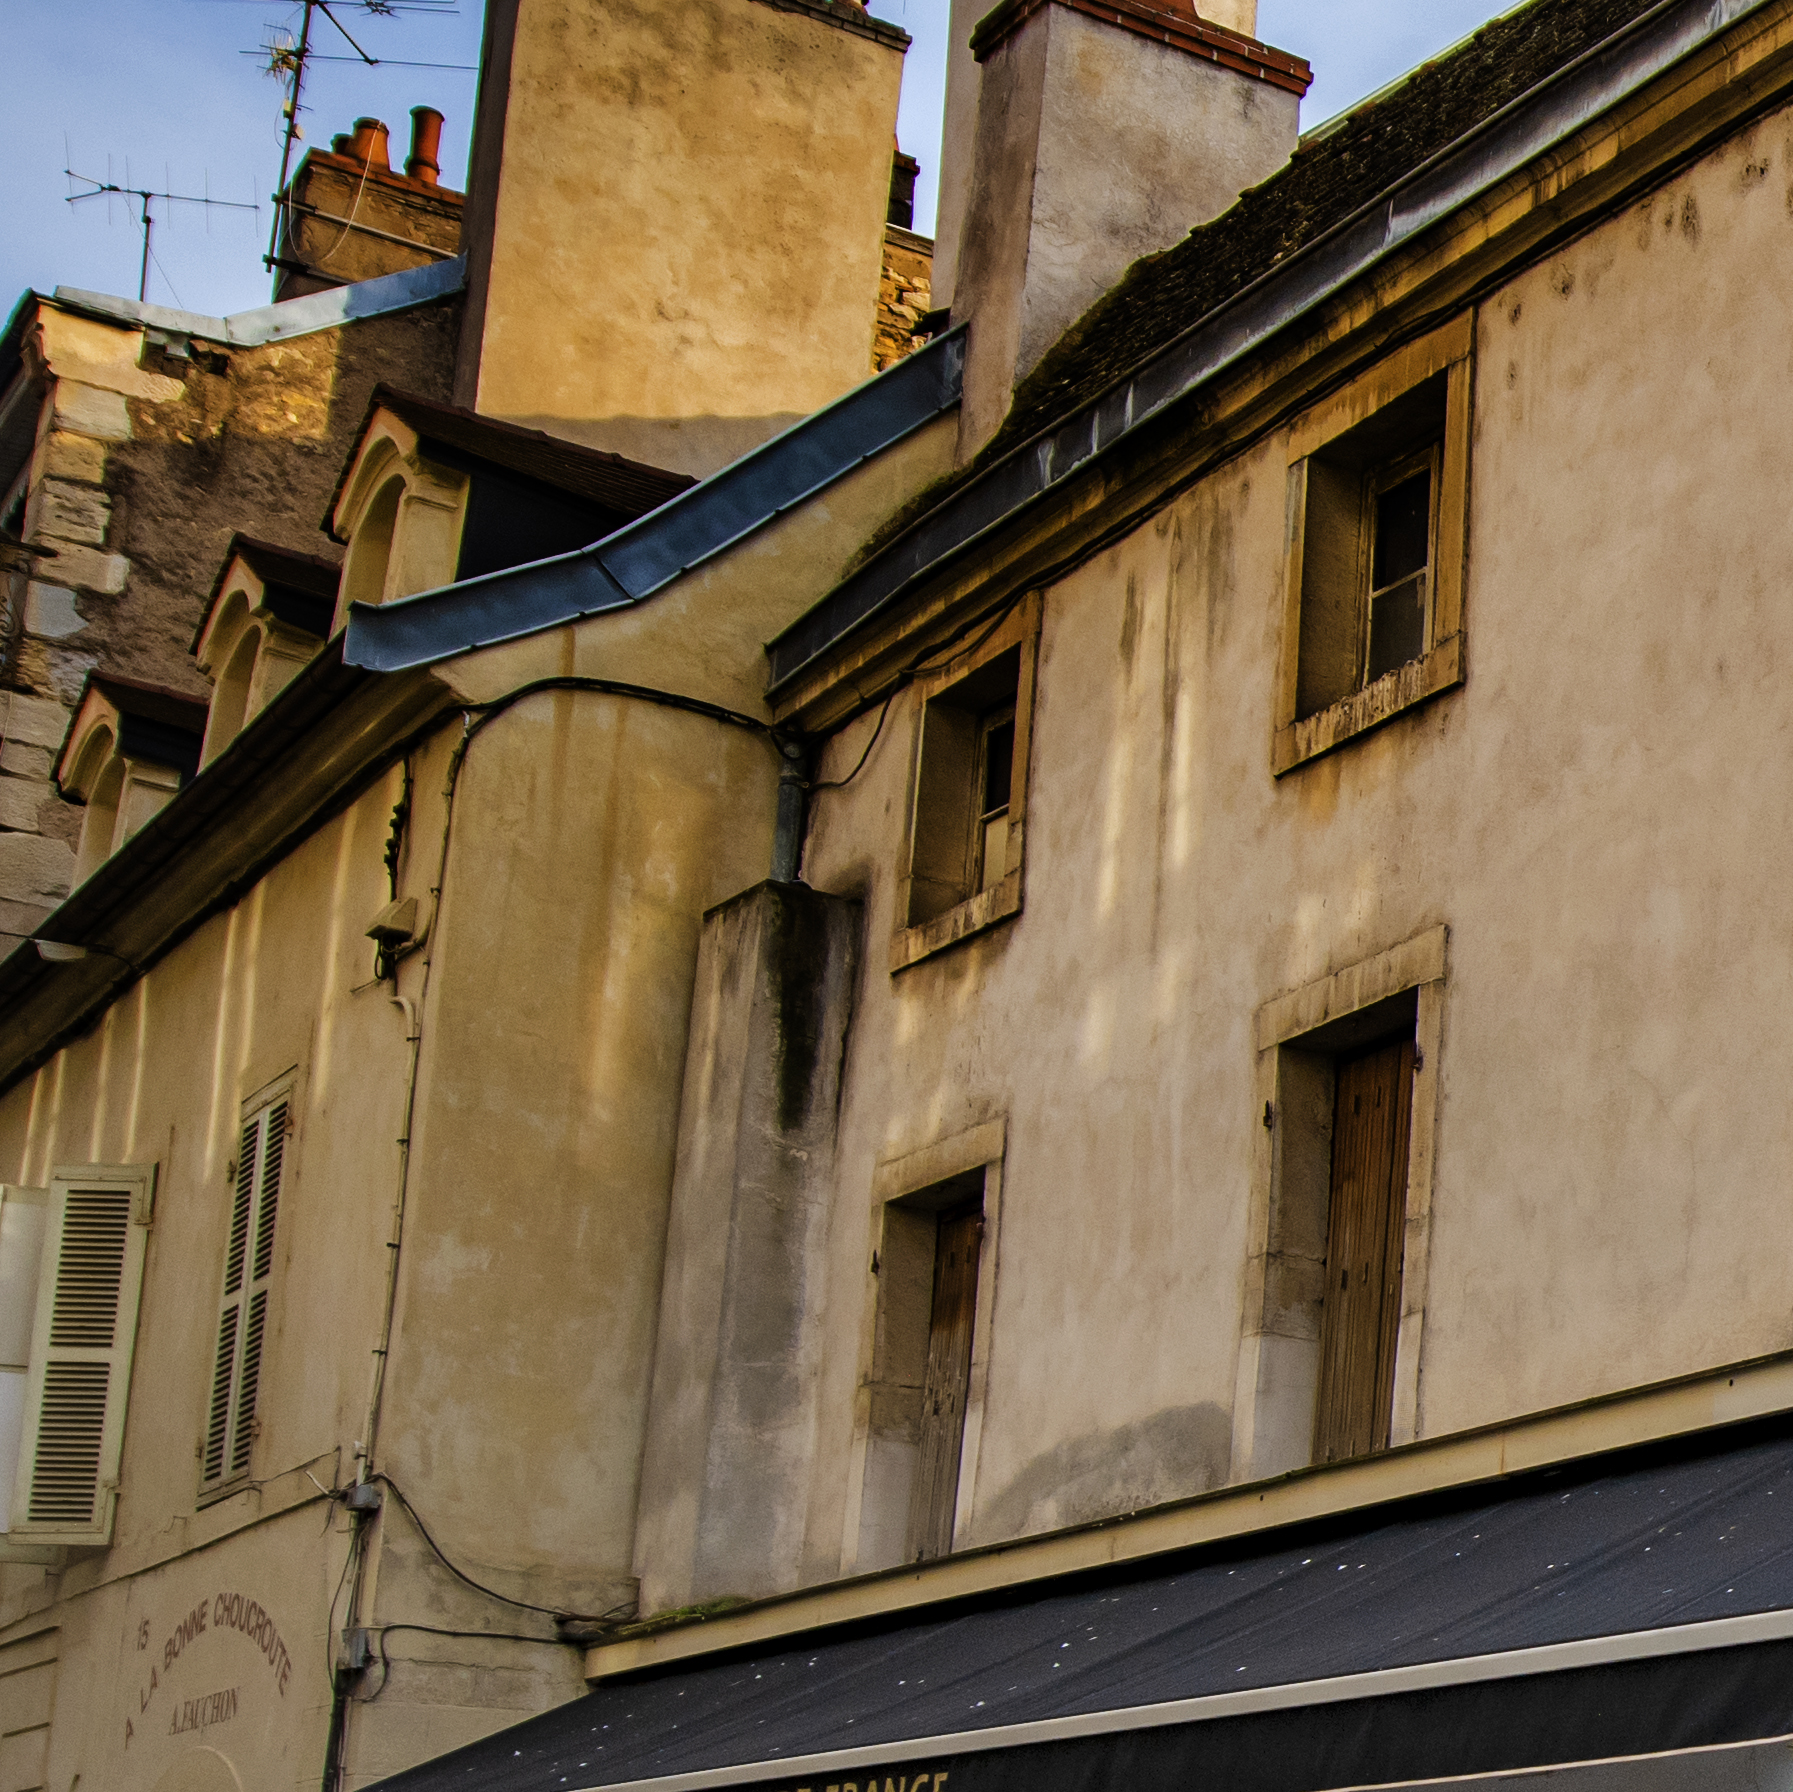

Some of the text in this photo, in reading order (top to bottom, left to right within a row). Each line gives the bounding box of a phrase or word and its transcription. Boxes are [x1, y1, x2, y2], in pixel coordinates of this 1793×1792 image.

[125, 1592, 292, 1750] A LA BONNE CHOUCROUTE
[137, 1618, 150, 1651] 15
